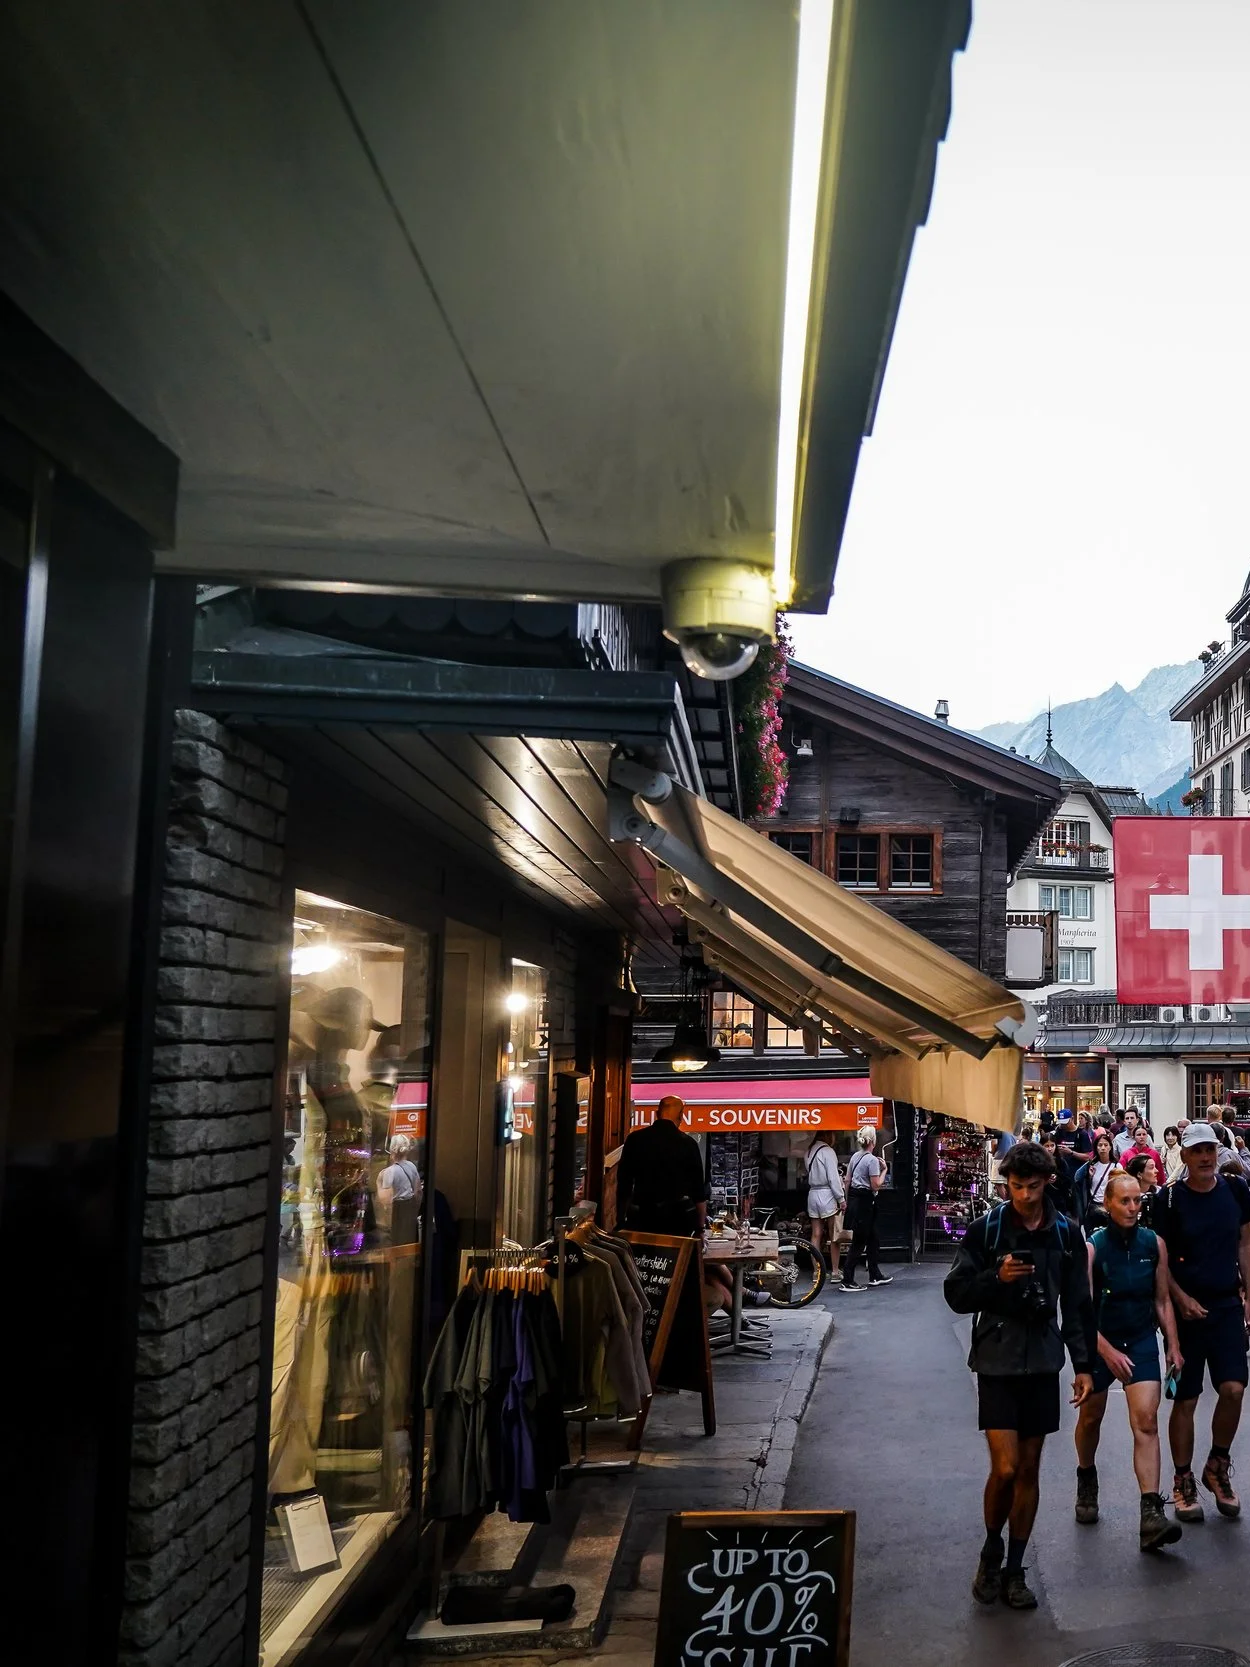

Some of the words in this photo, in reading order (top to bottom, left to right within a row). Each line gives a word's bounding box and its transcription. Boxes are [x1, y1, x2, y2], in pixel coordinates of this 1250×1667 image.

[1059, 928, 1097, 939] Margherita
[709, 1108, 822, 1126] SOUVENIRS
[712, 1549, 759, 1577] UP
[764, 1549, 810, 1576] TO
[701, 1582, 820, 1636] 40%
